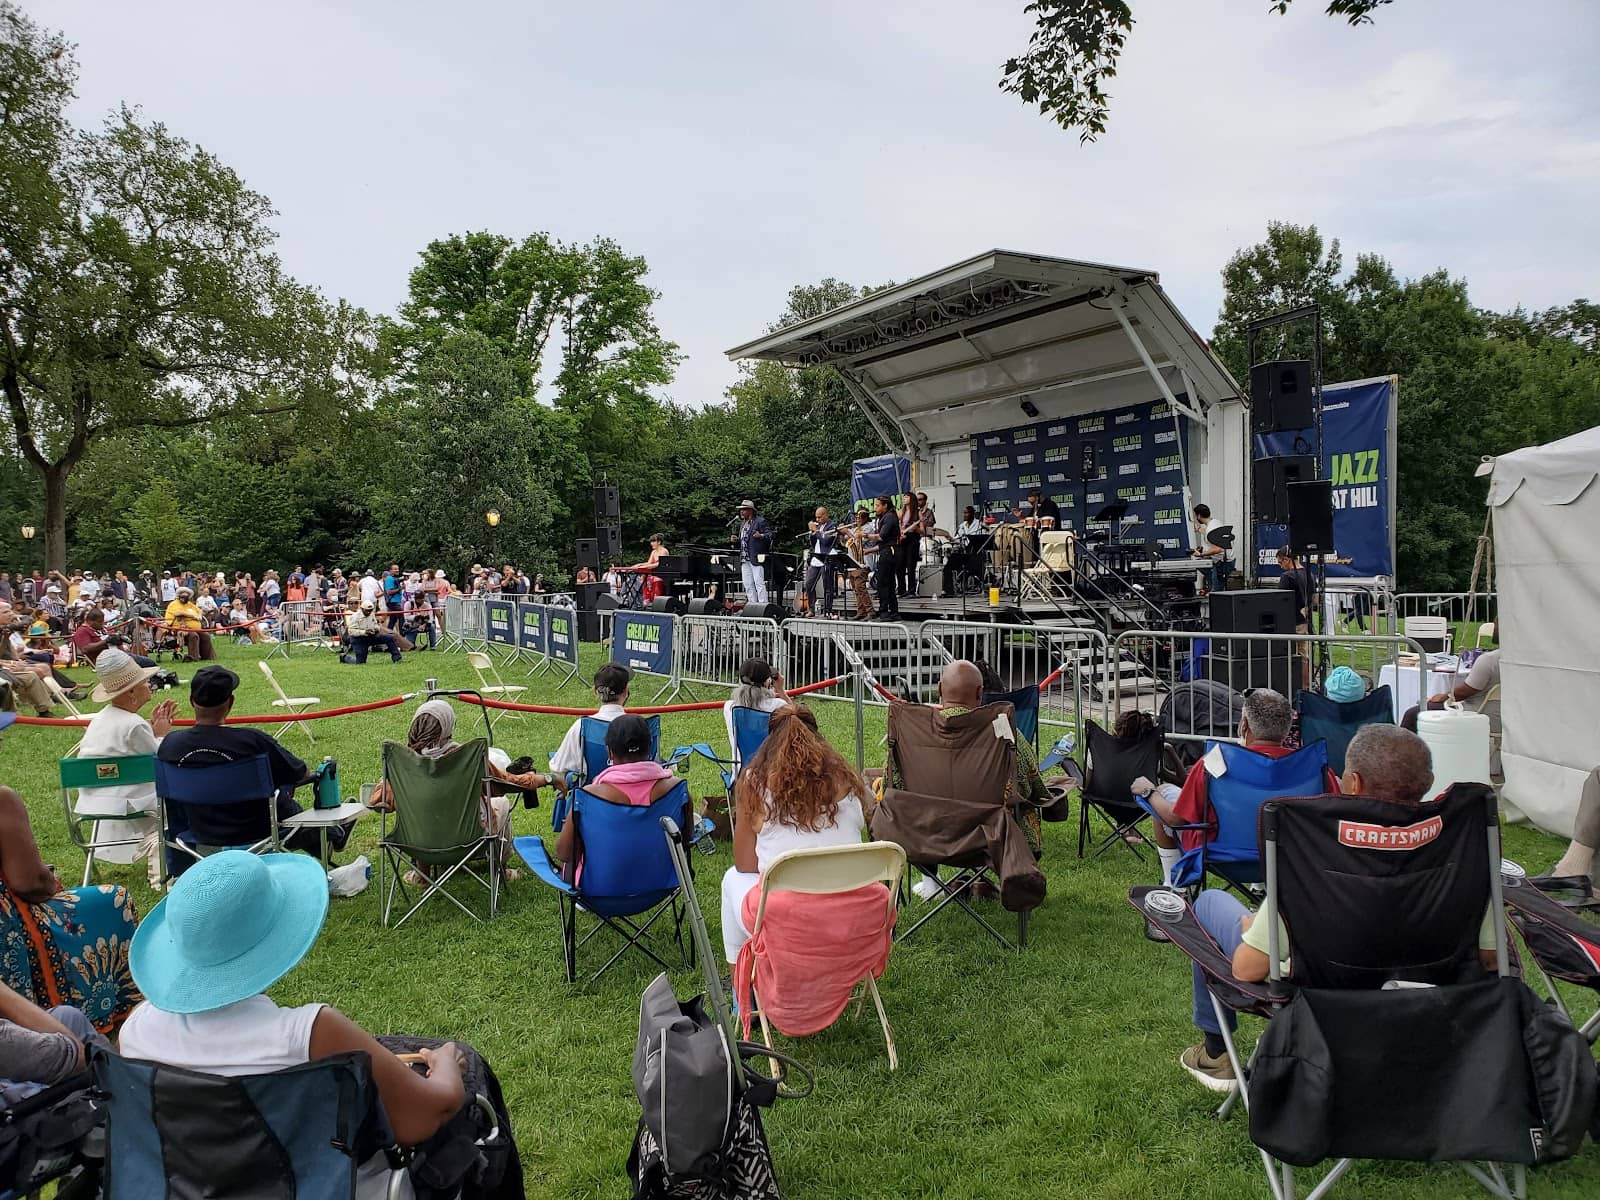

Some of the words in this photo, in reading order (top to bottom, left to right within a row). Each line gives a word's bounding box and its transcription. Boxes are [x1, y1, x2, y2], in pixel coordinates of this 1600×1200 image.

[1331, 449, 1379, 487] JAZZ
[1350, 486, 1378, 508] HILL
[627, 622, 645, 641] GREAT
[645, 624, 660, 642] JAZZ
[1345, 825, 1438, 845] CRAFTSMAN
